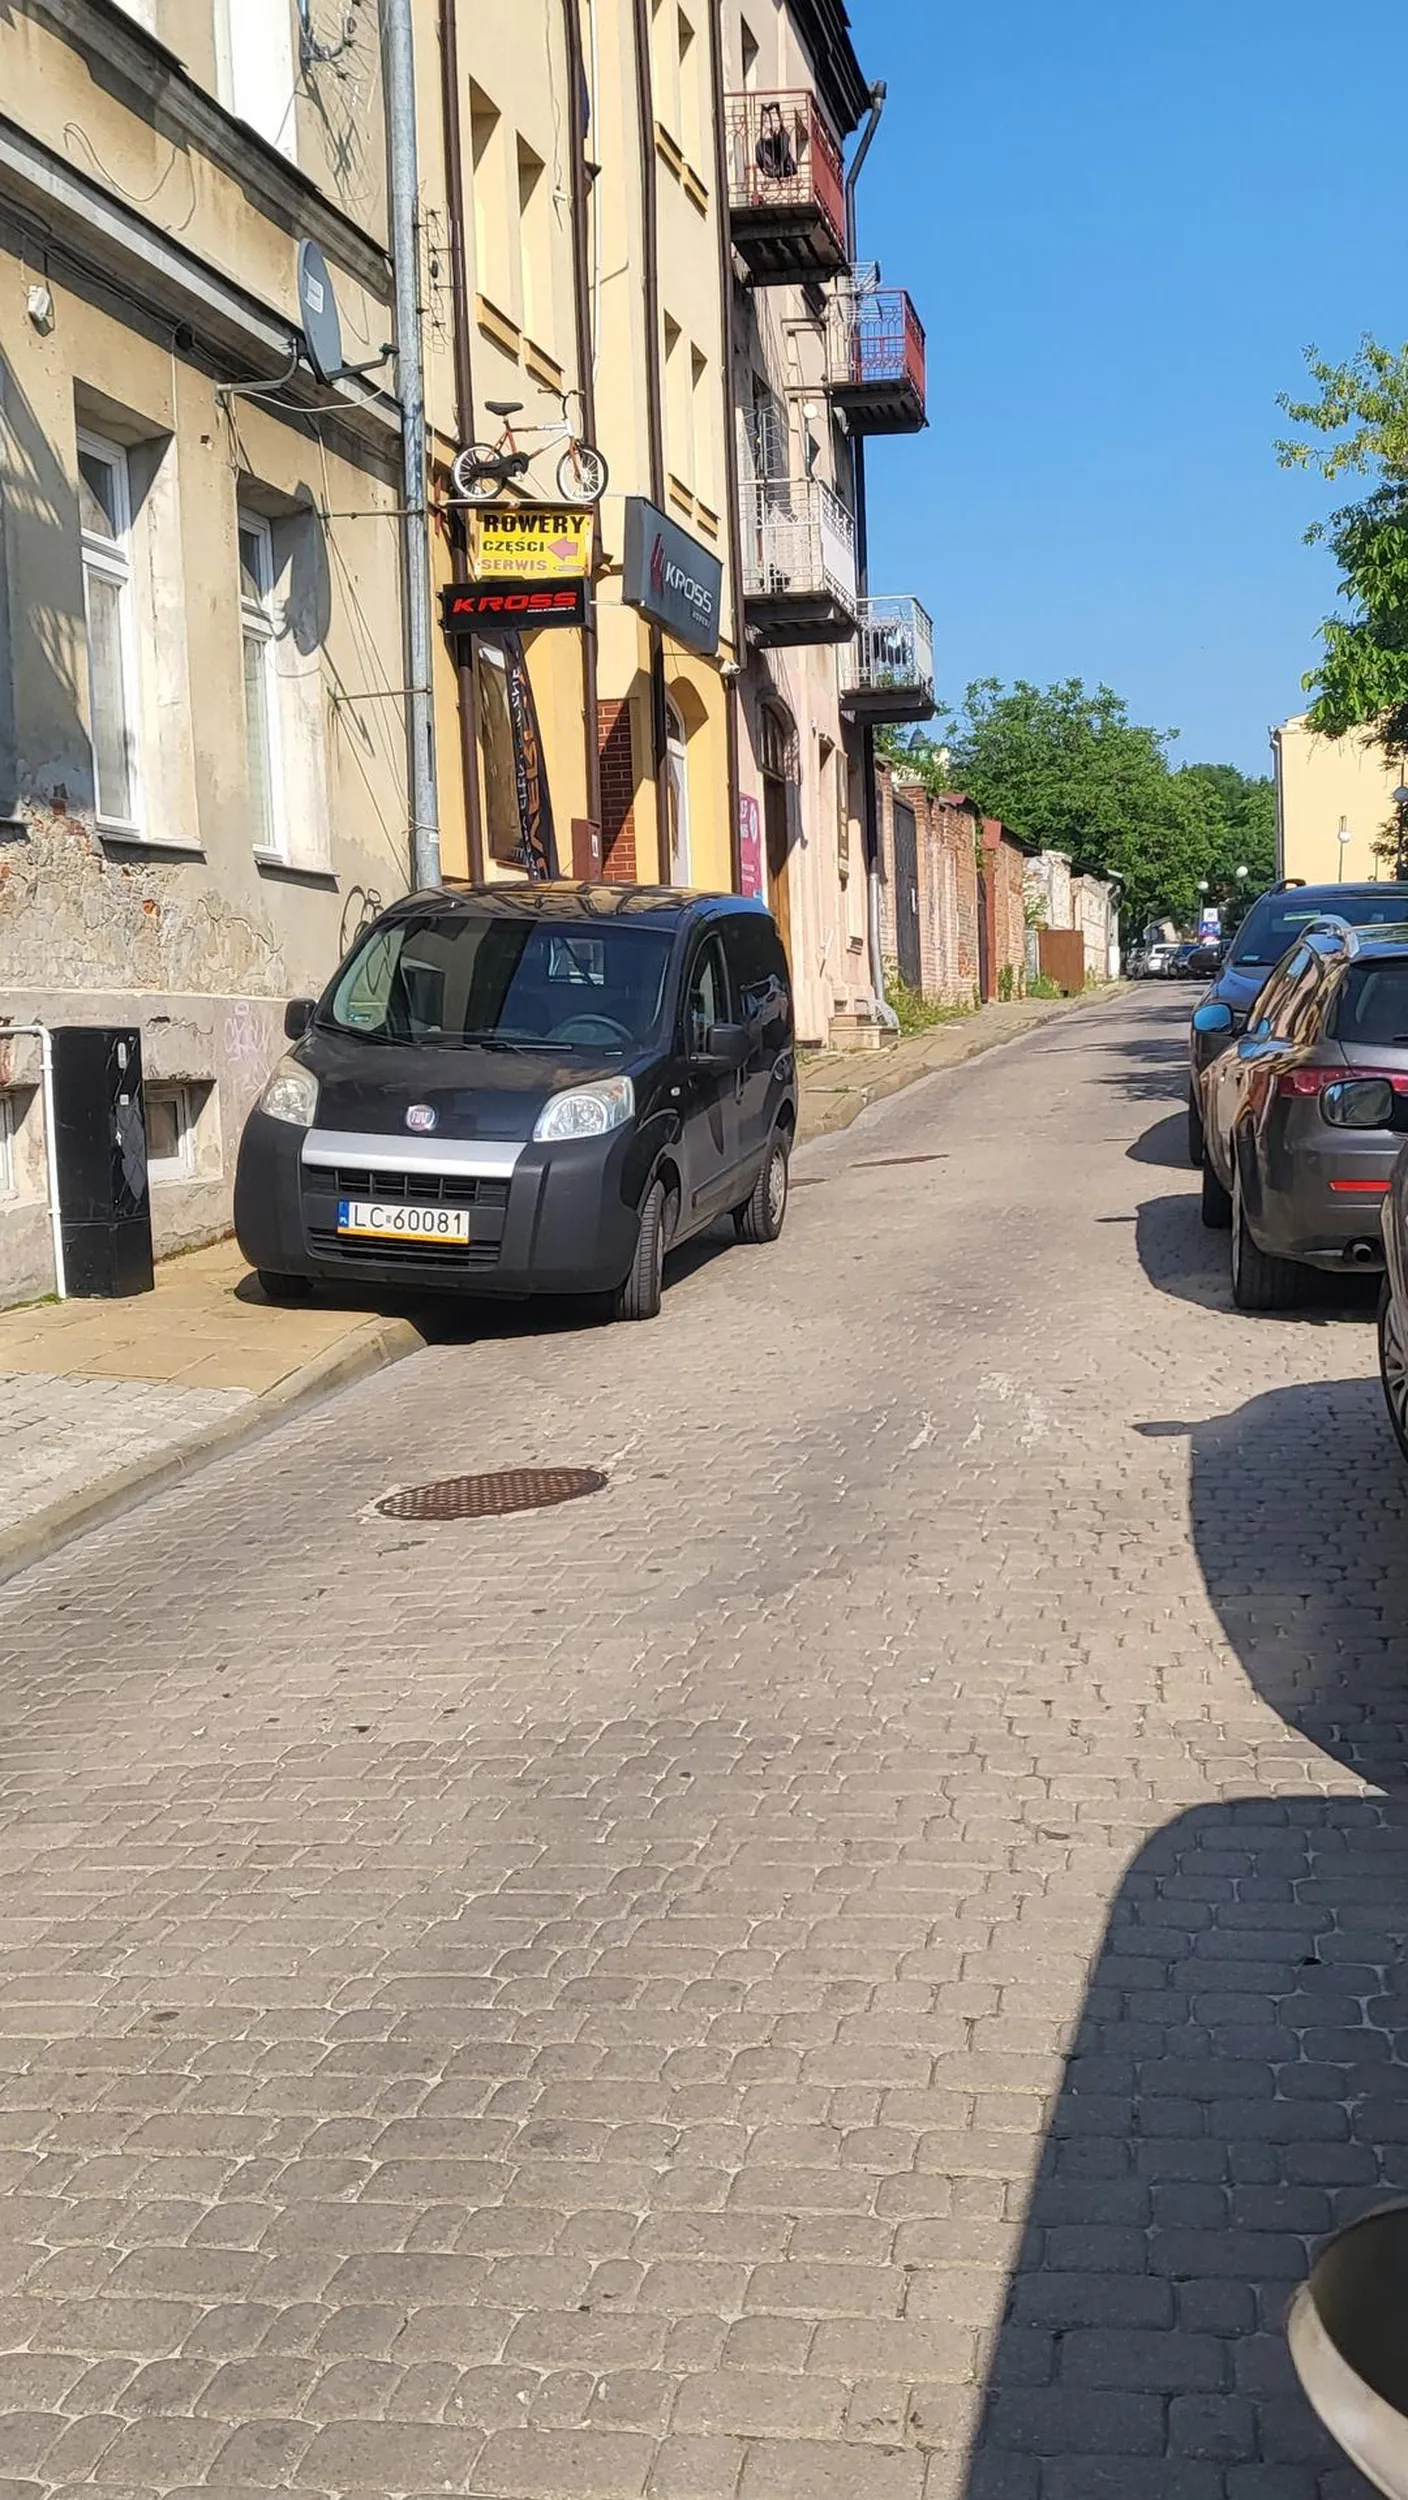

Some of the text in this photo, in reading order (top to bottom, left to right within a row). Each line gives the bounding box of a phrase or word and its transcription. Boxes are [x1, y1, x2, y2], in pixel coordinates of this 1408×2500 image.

[484, 514, 585, 534] ROWERY
[482, 537, 545, 554] CZĘŚCI
[481, 559, 547, 571] SERWIS
[665, 561, 713, 614] KROSS
[452, 591, 578, 613] KROSS
[354, 1205, 461, 1234] LC 60081
